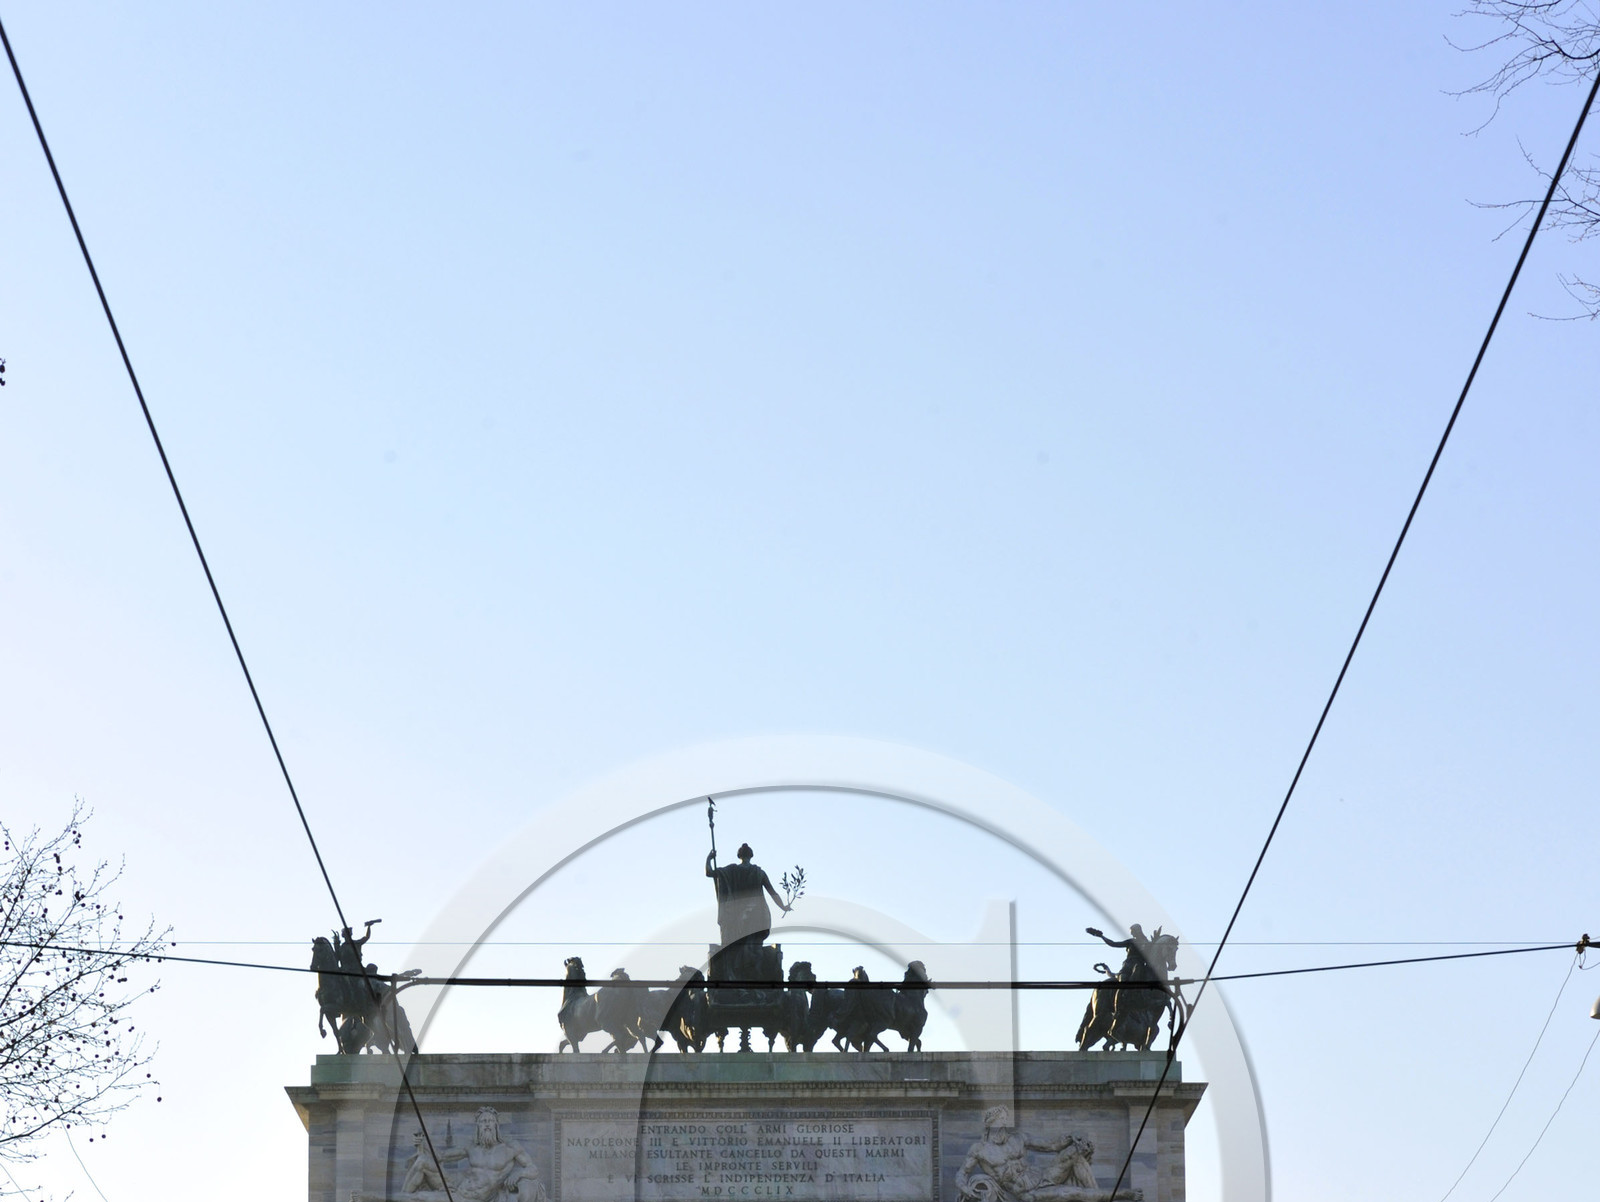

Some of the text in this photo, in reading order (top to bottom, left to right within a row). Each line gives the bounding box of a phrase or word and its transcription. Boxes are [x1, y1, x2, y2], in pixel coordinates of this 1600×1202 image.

[641, 1125, 706, 1135] ENTRANDO
[757, 1124, 787, 1134] ARMI
[796, 1124, 855, 1134] GLORIOSE
[567, 1136, 926, 1147] NAPOLEONE III E VITTORIO EMANUELE II LIBERATORI
[589, 1150, 637, 1159] MILANO
[647, 1149, 713, 1159] ESULTANTE
[790, 1149, 806, 1159] DA
[815, 1148, 856, 1159] QUESTI
[865, 1148, 905, 1158] MARMI
[676, 1161, 818, 1171] LE IMPRONTE SERVILI
[607, 1174, 614, 1184] E
[624, 1174, 638, 1184] VI
[647, 1174, 695, 1184] SCRISSE
[720, 1173, 815, 1183] INDIPENDENZA
[843, 1173, 886, 1183] ITALIA
